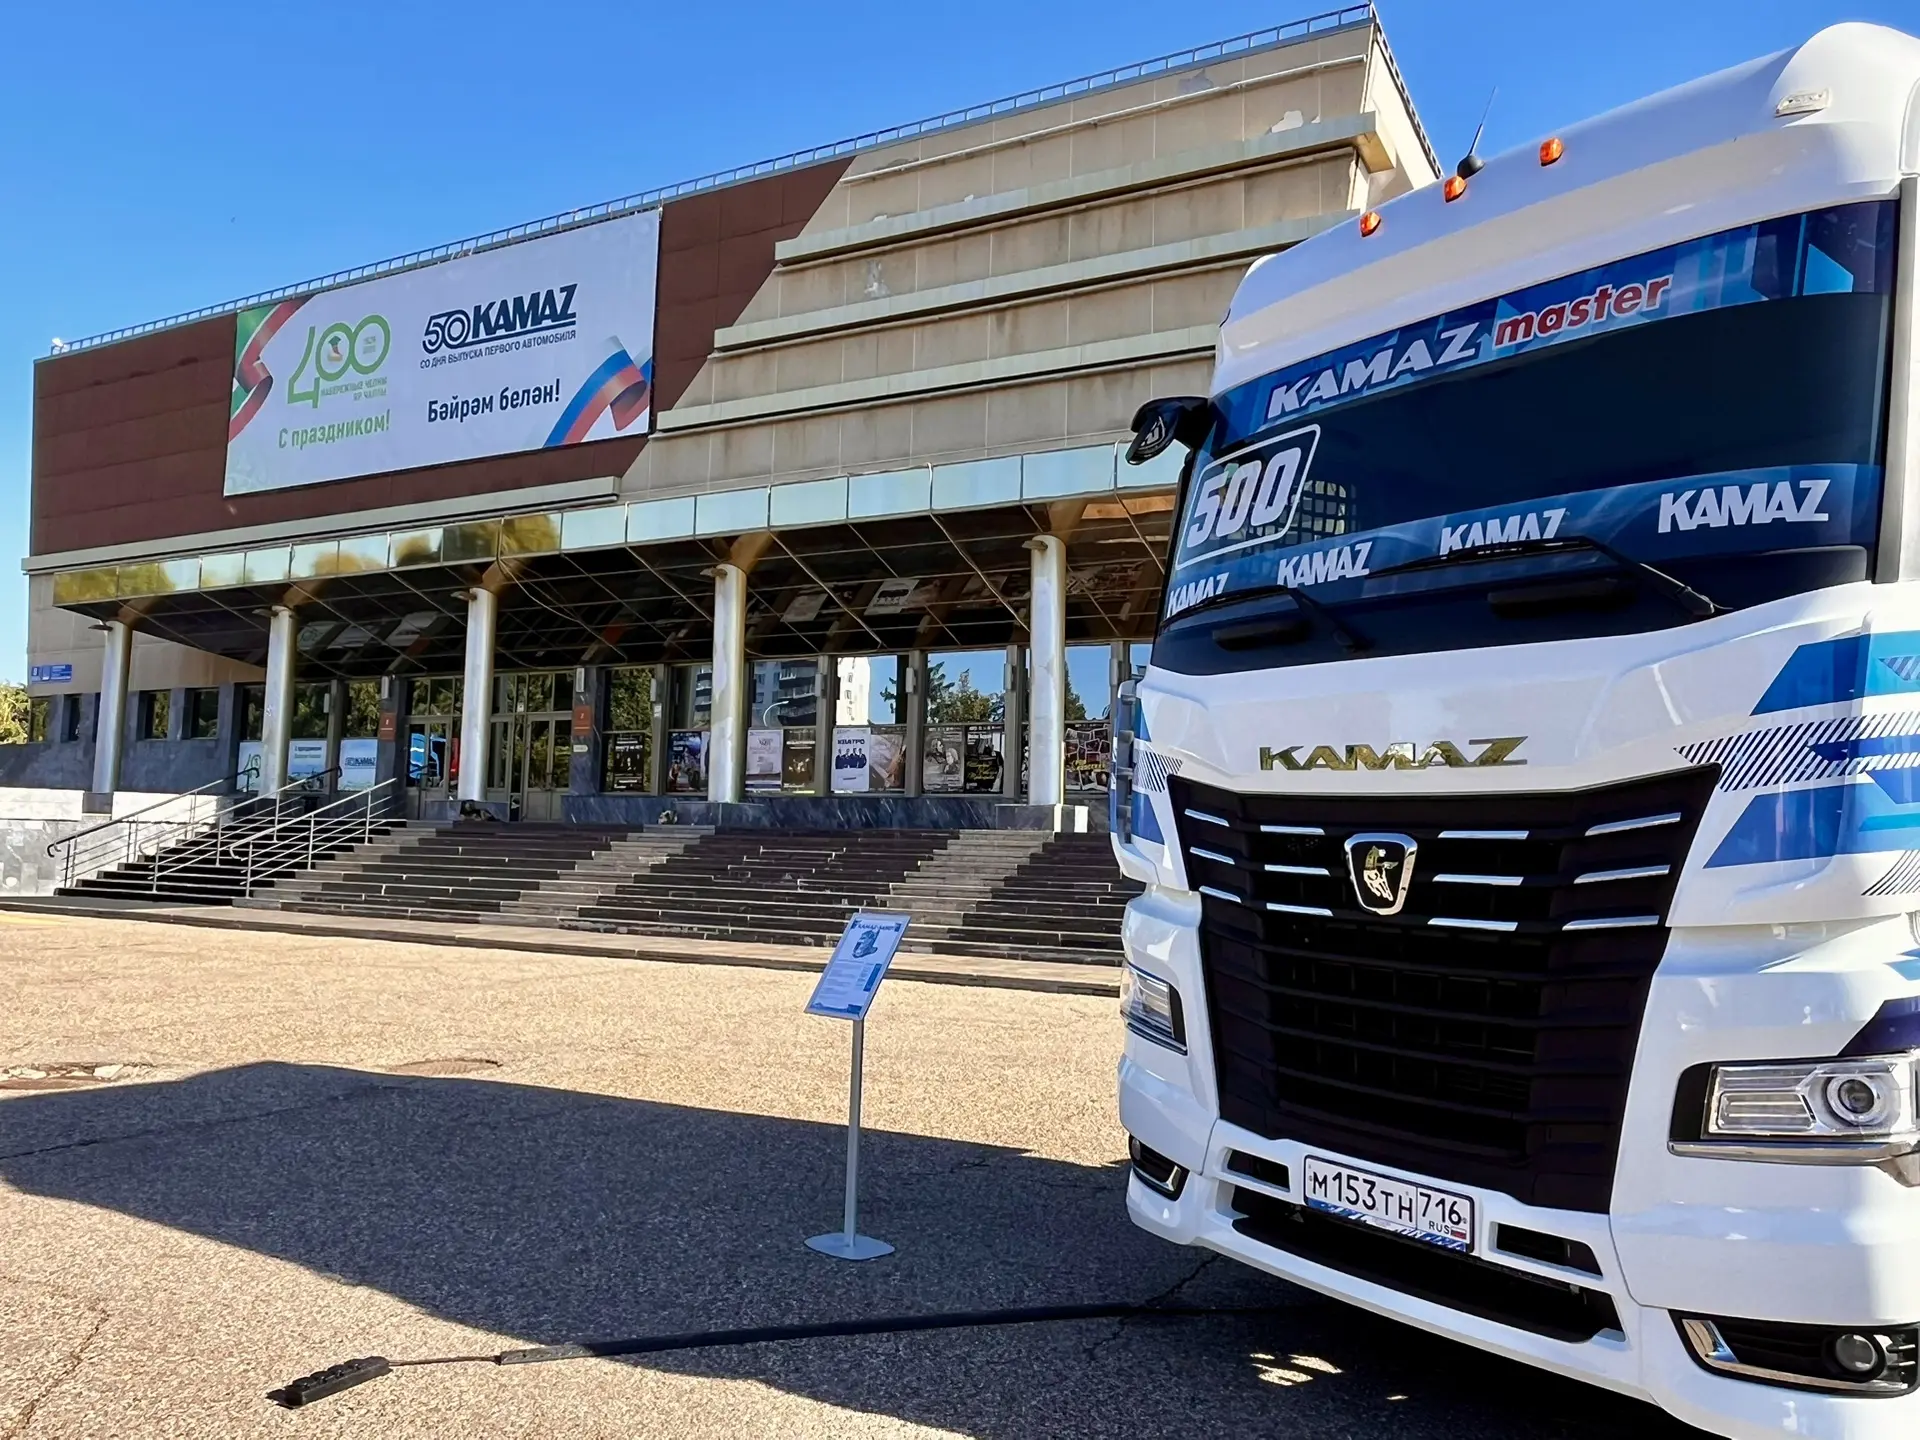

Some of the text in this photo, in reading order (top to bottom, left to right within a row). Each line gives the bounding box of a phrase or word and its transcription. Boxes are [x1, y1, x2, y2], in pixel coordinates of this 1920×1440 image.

[472, 283, 578, 339] KAMAZ
[420, 330, 576, 369] СО ДНЯ ВЫПУСКА ПЕРВОГО АВТОМОБИЛЯ
[1267, 274, 1673, 419] KAMAZ master
[428, 378, 560, 423] Бәйрәм белән!
[291, 409, 390, 450] праздником!
[1186, 447, 1302, 548] 500
[1657, 479, 1831, 534] KAMAZ
[1439, 508, 1566, 556] KAMAZ
[1277, 541, 1373, 589] KAMAZ
[1167, 572, 1230, 618] KAMAZ
[1259, 736, 1529, 770] KAMAZ
[1419, 1192, 1462, 1226] 716
[1429, 1220, 1450, 1235] RUS
